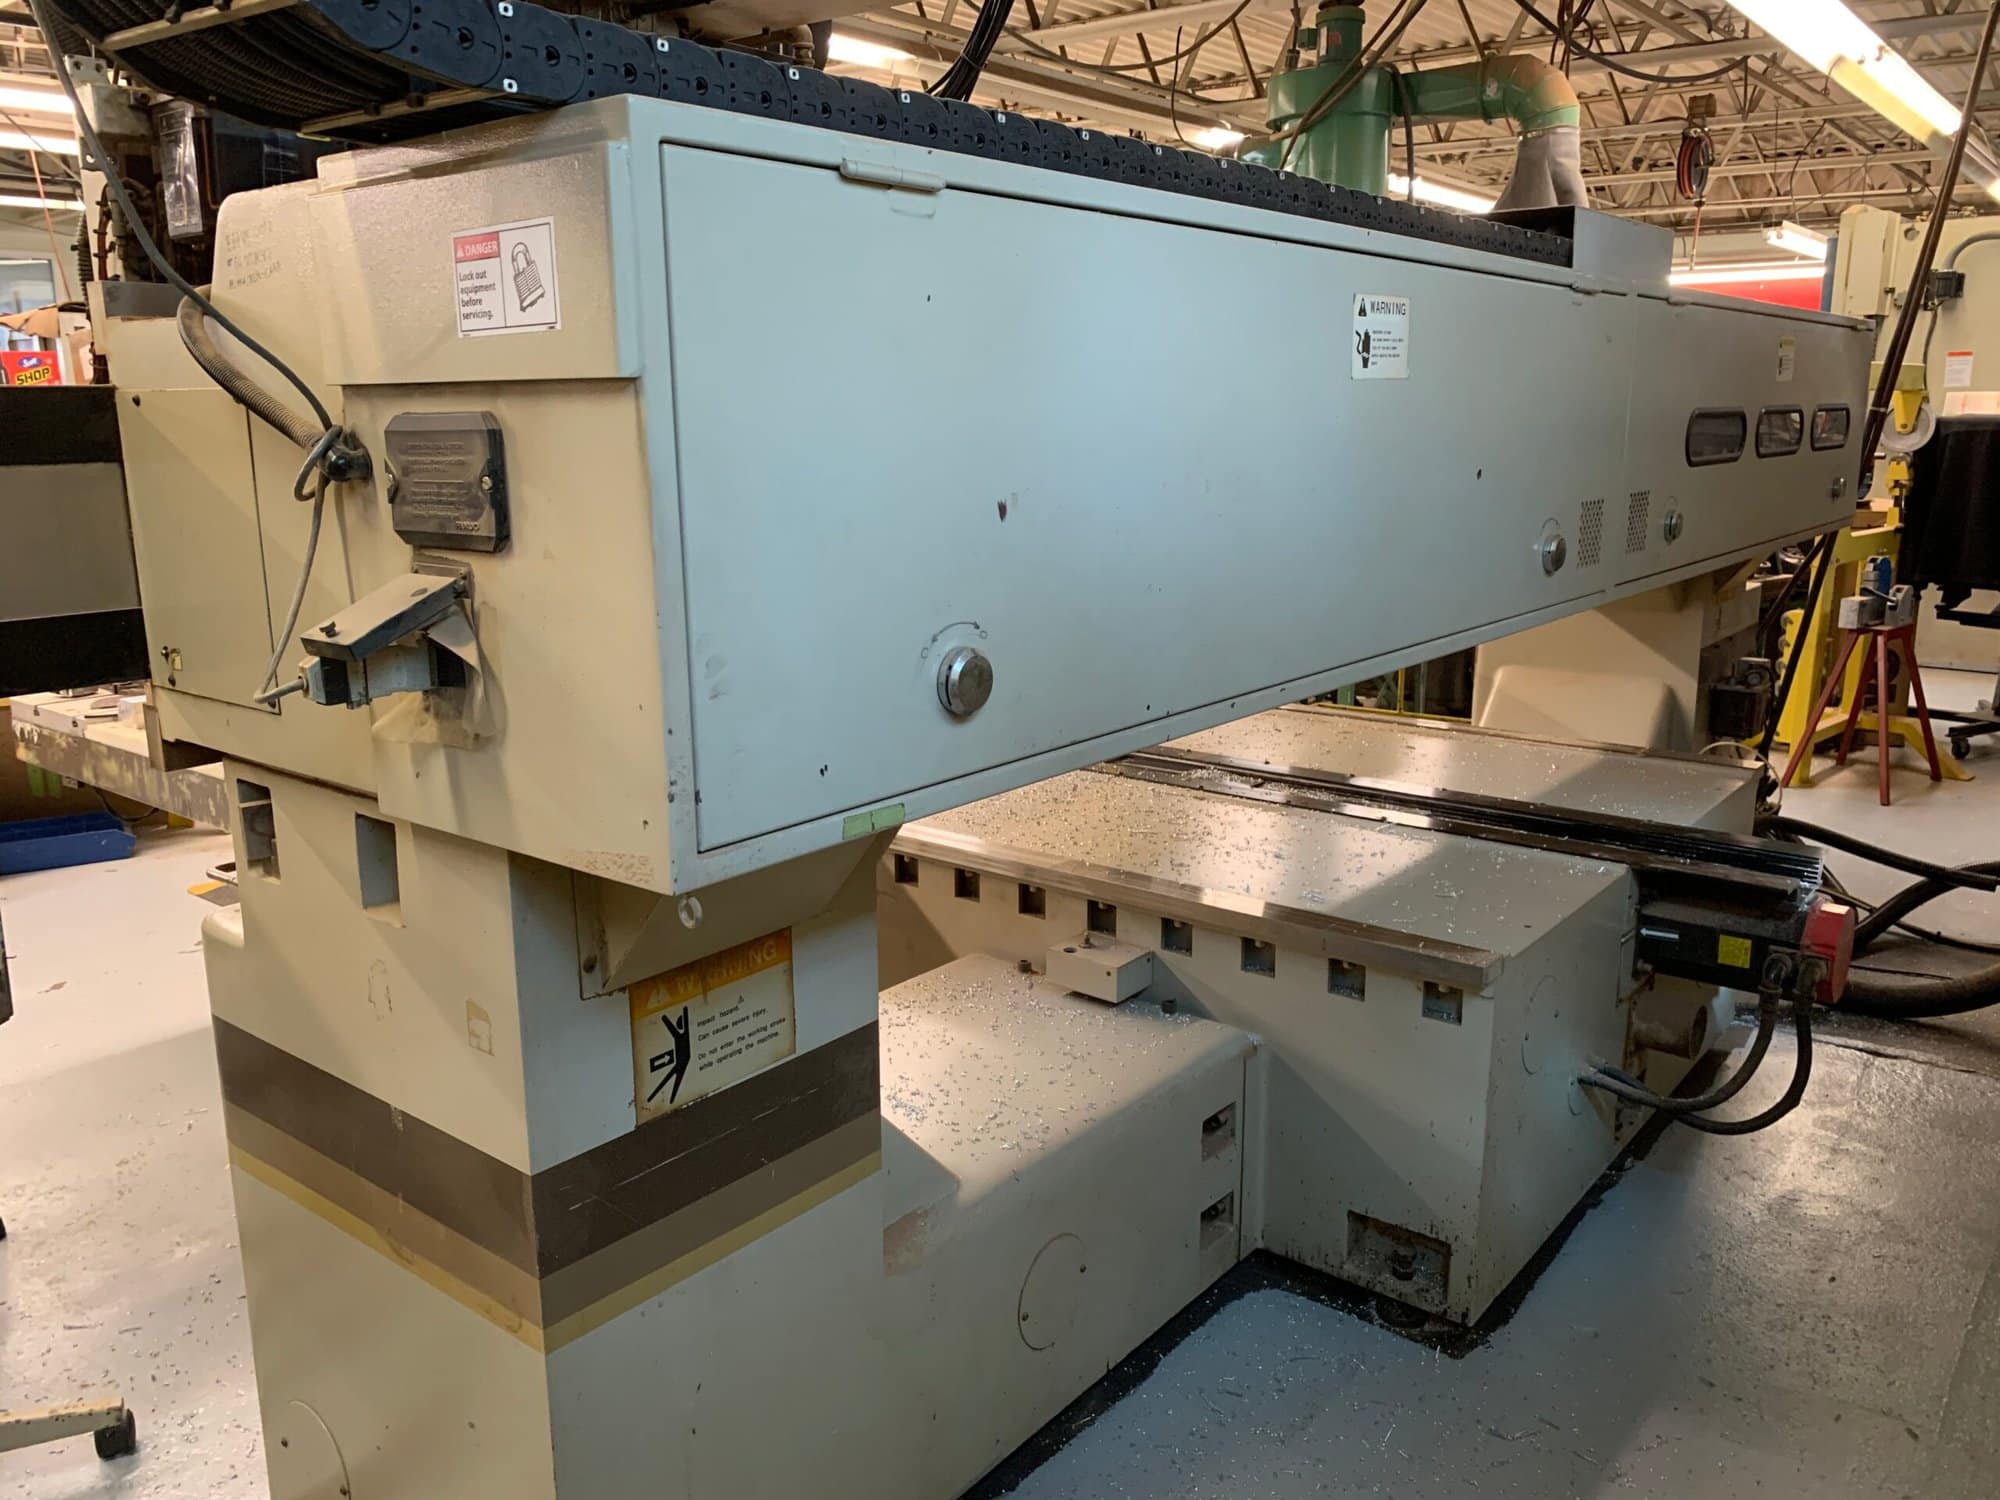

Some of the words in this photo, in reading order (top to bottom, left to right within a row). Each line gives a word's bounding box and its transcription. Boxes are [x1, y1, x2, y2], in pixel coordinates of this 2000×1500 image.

[465, 240, 498, 256] DANGER
[459, 271, 474, 282] Lock
[475, 270, 487, 280] out
[460, 282, 496, 296] equipment
[462, 297, 483, 308] before
[1370, 301, 1406, 316] WARNING
[462, 309, 494, 321] servicing.
[16, 367, 50, 385] SHOP
